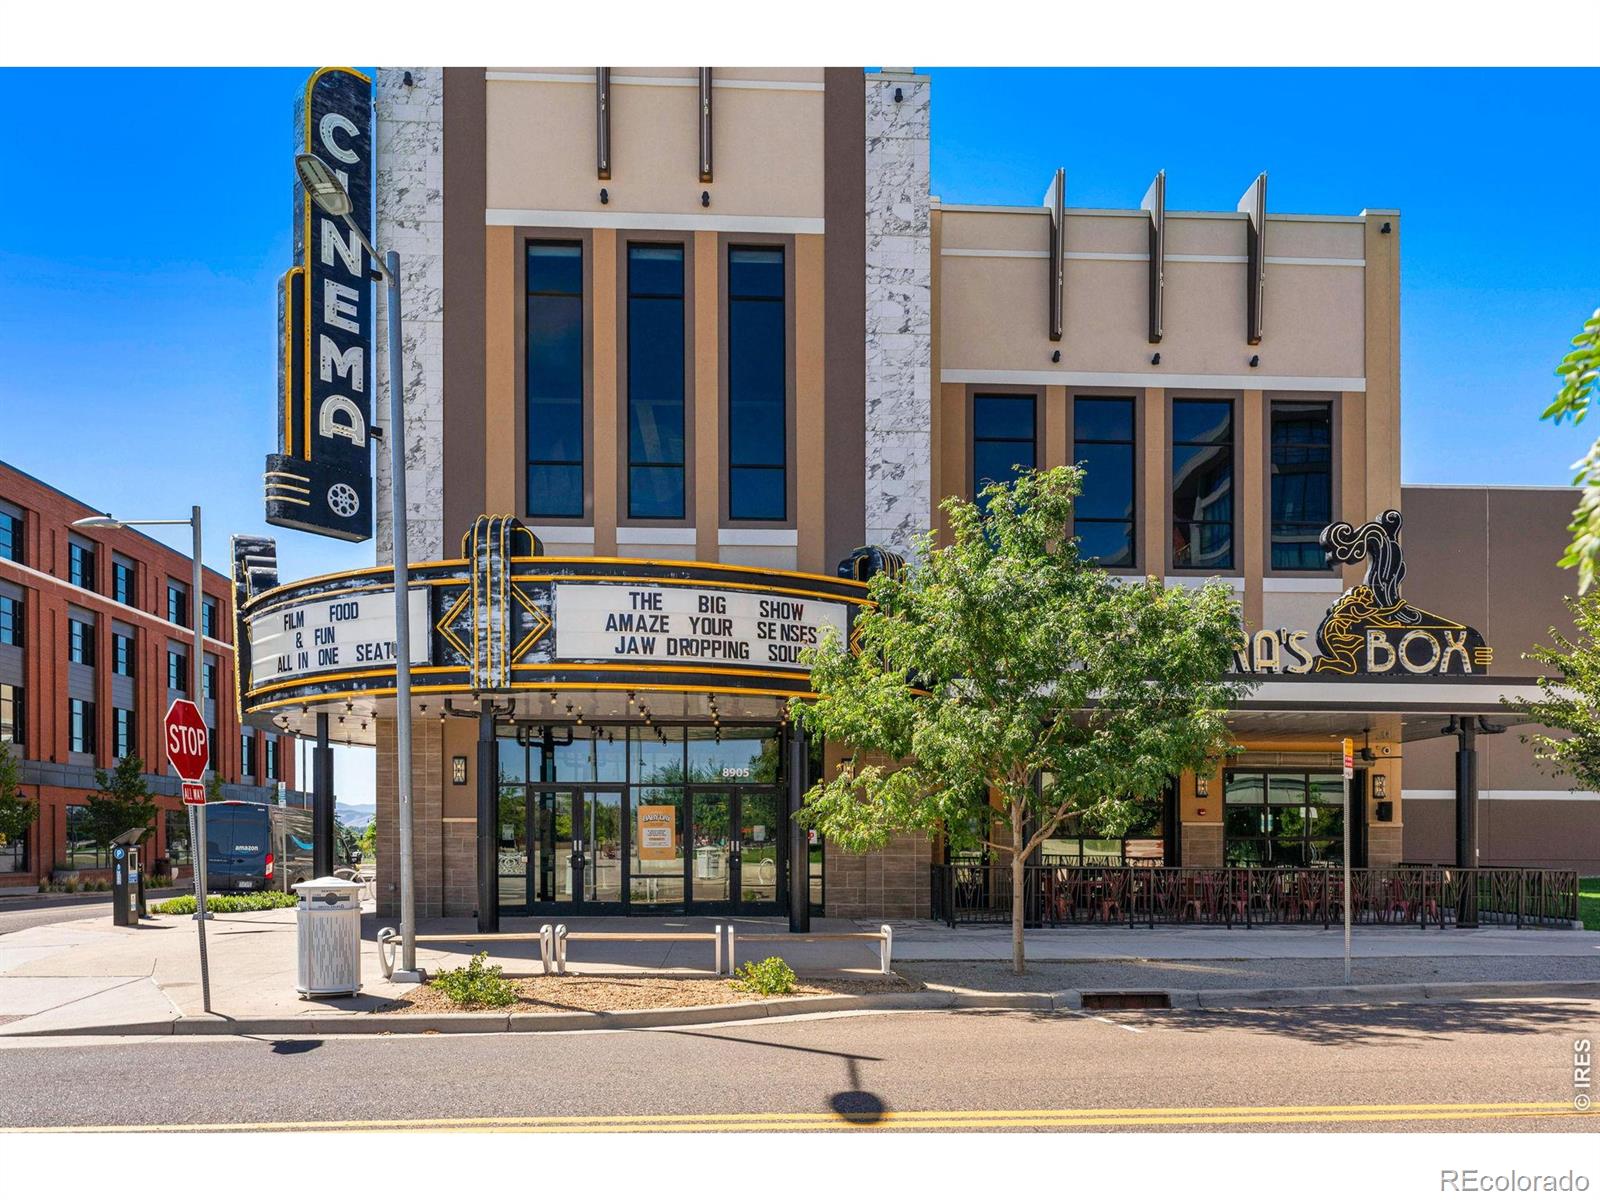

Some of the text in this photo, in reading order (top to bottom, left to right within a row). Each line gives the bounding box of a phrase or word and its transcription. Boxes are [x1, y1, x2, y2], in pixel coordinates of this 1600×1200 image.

[284, 601, 359, 632] FILM FOOD
[628, 591, 804, 621] THE BIG SHOW
[295, 626, 335, 648] & FUN
[605, 613, 818, 644] AMAZE YOUR SENSES
[277, 655, 292, 674] ALL
[298, 652, 309, 669] IN
[318, 647, 339, 667] ONE
[614, 636, 806, 664] JAW DROPPING SOU
[1366, 629, 1472, 673] BOX
[169, 723, 206, 756] STOP
[722, 767, 750, 777] 8905
[184, 787, 204, 801] ALL WAY
